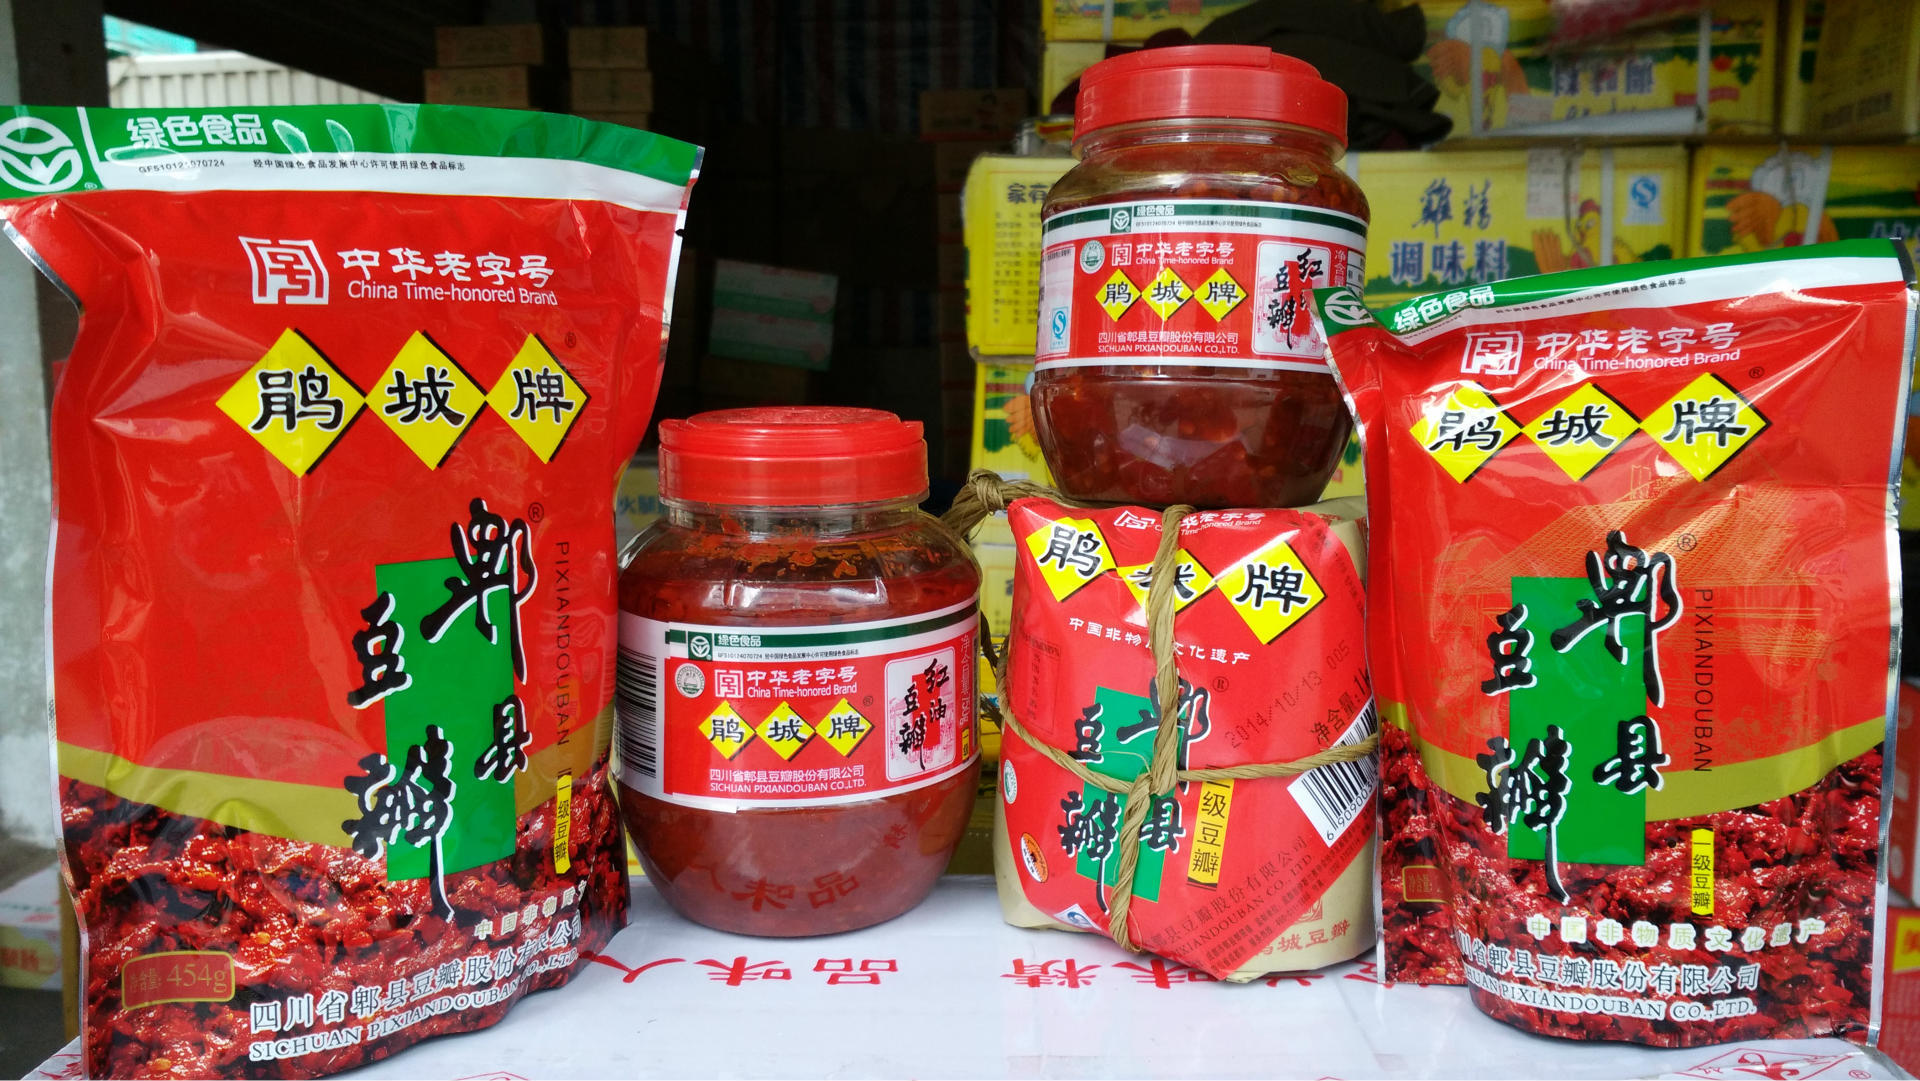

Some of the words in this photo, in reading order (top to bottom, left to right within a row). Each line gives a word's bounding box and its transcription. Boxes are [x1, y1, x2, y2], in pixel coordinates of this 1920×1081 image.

[126, 114, 268, 148] 绿色食品
[337, 247, 554, 287] 中华老字号
[1136, 241, 1235, 258] 中华老字号
[1211, 257, 1234, 265] Brand
[1389, 238, 1510, 285] 调味料
[348, 280, 398, 300] China
[402, 281, 516, 303] Time-honored
[520, 288, 558, 306] Brand
[1103, 280, 1240, 304] 鹃城牌
[1394, 285, 1496, 333] 绿色食品
[1098, 344, 1133, 353] SICHUAN
[1536, 322, 1741, 357] 中华老字号
[1533, 356, 1577, 371] China
[1580, 354, 1690, 371] Time-honored
[1693, 348, 1741, 365] Brand
[249, 364, 576, 434] 鹃城牌
[1424, 396, 1750, 452] 鹃城牌
[1178, 511, 1266, 531] 华老字号
[555, 540, 571, 747] PIXIANDOUBAN
[1069, 616, 1251, 665] 中国非物文化遗产
[747, 665, 858, 687] 中华老字号
[747, 686, 771, 698] China
[772, 685, 832, 698] Time-honored
[833, 682, 858, 695] Brand
[1693, 588, 1715, 773] PIXIANDOUBAN
[709, 713, 865, 743] 鹃城牌
[709, 765, 865, 783] 四川省郫县豆瓣股份有限公司
[710, 782, 752, 793] SICHUAN
[753, 782, 828, 794] PIXIANDOUBAN
[1192, 780, 1232, 876] 一级豆瓣
[1693, 840, 1711, 909] 一级豆瓣
[1527, 914, 1826, 951] 中国非物质文化遗产
[166, 962, 229, 994] 454g
[251, 909, 583, 1034] 四川省郫县豆瓣股份有限公司
[1455, 929, 1761, 996] 川省郫县豆瓣股份有限公司
[1501, 980, 1666, 1020] PIXIANDOUBAN
[249, 1026, 363, 1062] SICHUAN
[367, 976, 520, 1041] PIXIANDOUBAN
